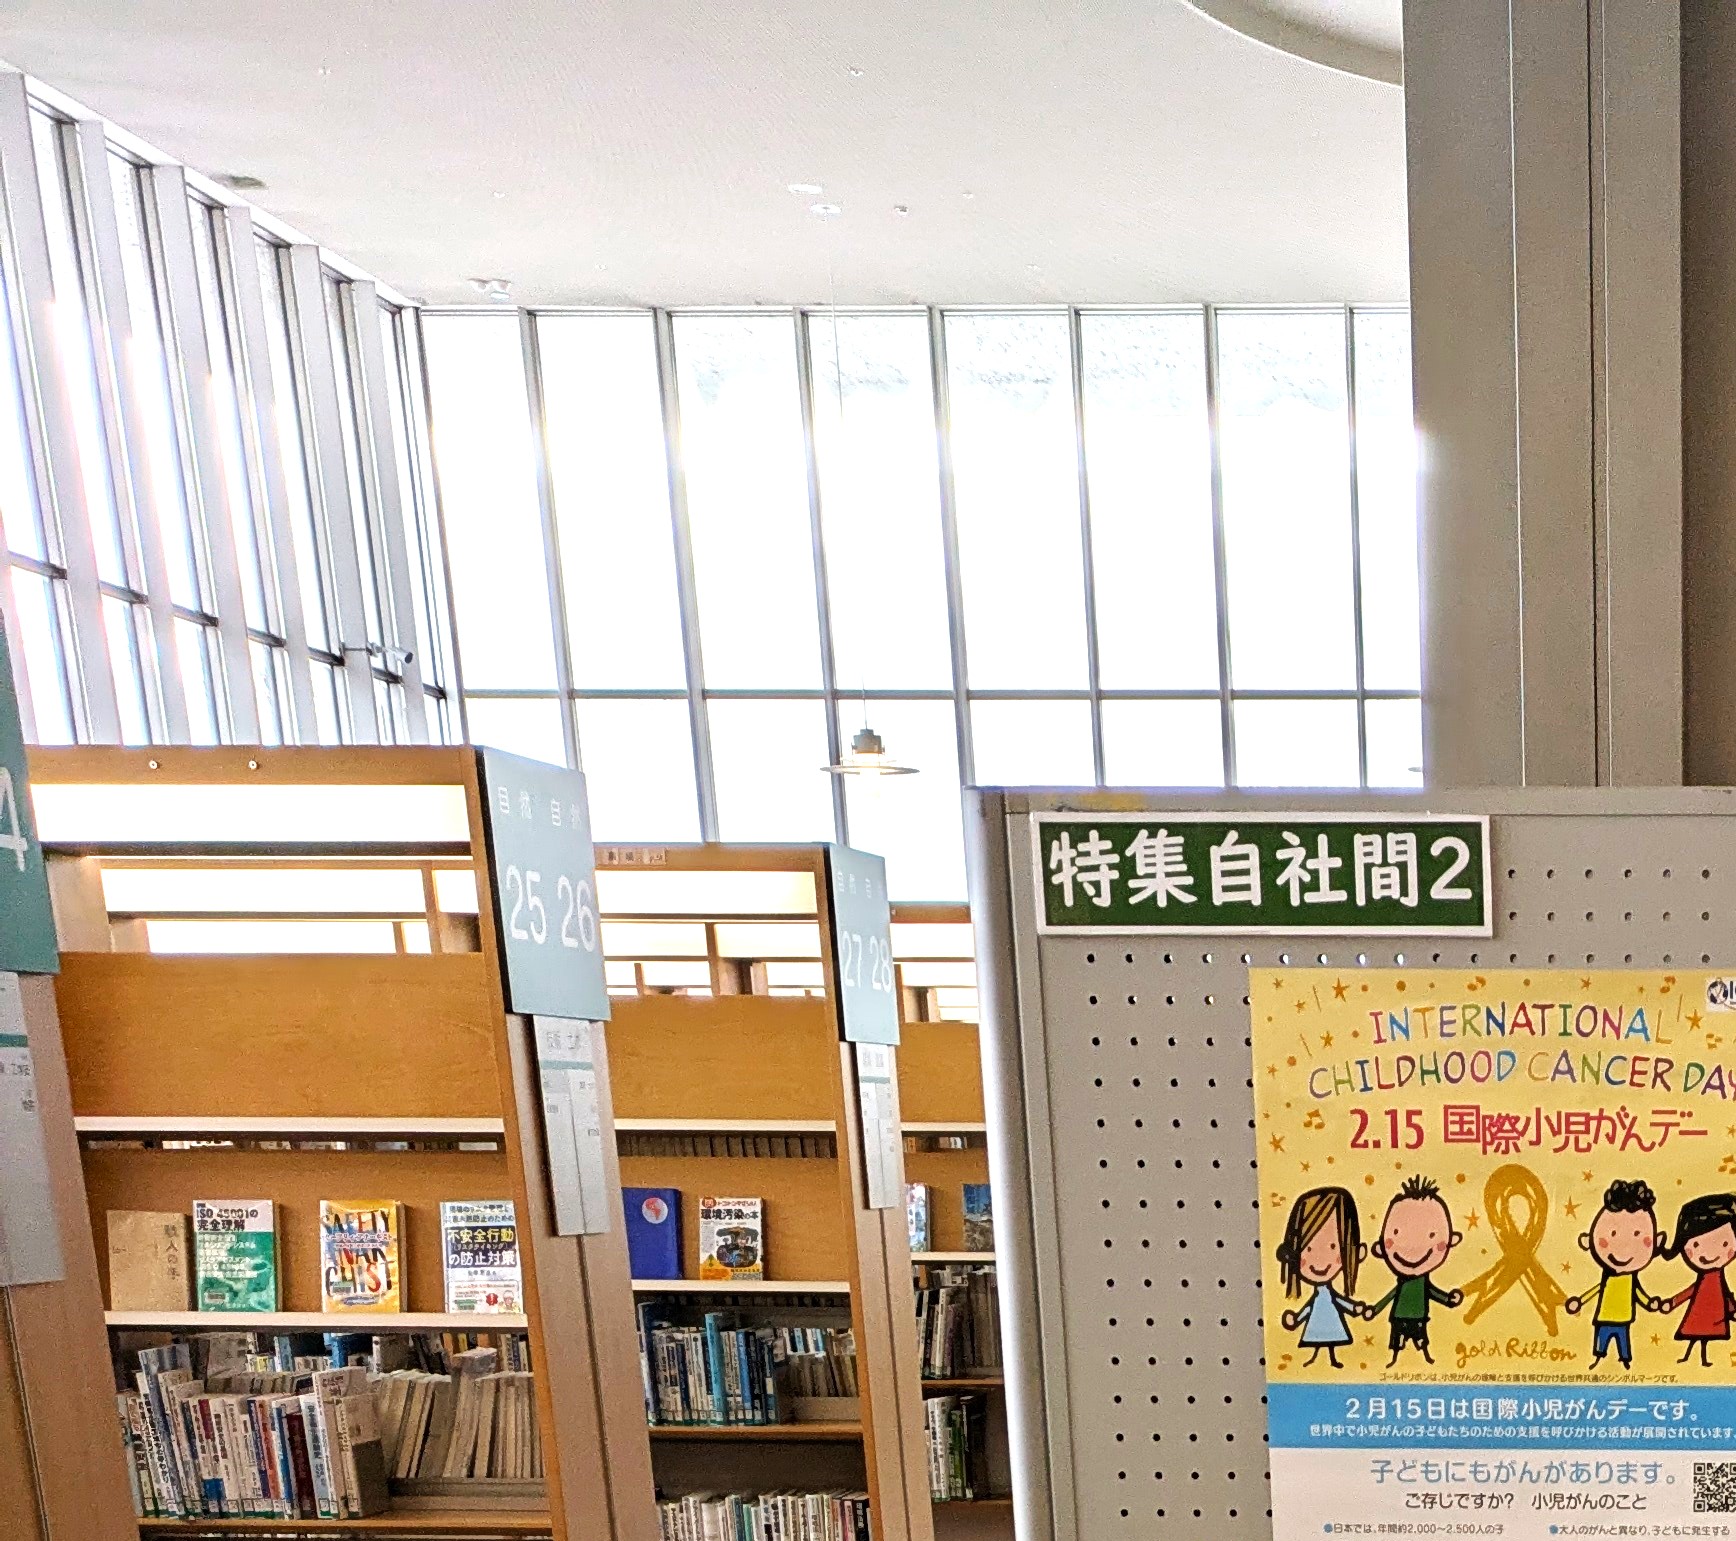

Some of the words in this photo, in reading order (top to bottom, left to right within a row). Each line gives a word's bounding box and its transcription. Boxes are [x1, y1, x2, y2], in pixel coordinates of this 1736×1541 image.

[1050, 829, 1473, 908] 特集自社間2
[506, 865, 547, 944] 25
[557, 875, 595, 952] 26
[842, 931, 863, 989] 27
[868, 937, 891, 992] 28
[1369, 1001, 1672, 1045] INTERNATIONAL
[1309, 1049, 1516, 1099] CHILDHOOD
[1528, 1050, 1672, 1093] CANCER
[1349, 1108, 1425, 1150] 2.15
[1443, 1104, 1708, 1155] 国際小児がんデー
[197, 1209, 213, 1218] ISO
[197, 1219, 245, 1231] 完全理解
[701, 1209, 759, 1220] 環境汚染の本
[447, 1228, 513, 1243] 不安全行動
[449, 1250, 515, 1265] の防止対策
[1456, 1339, 1501, 1369] gold
[1345, 1398, 1698, 1422] 2月15日は国際小児がんデーです。
[1371, 1458, 1677, 1485] 子どもにもがんがあります。
[1532, 1492, 1647, 1511] 小児がんのこと
